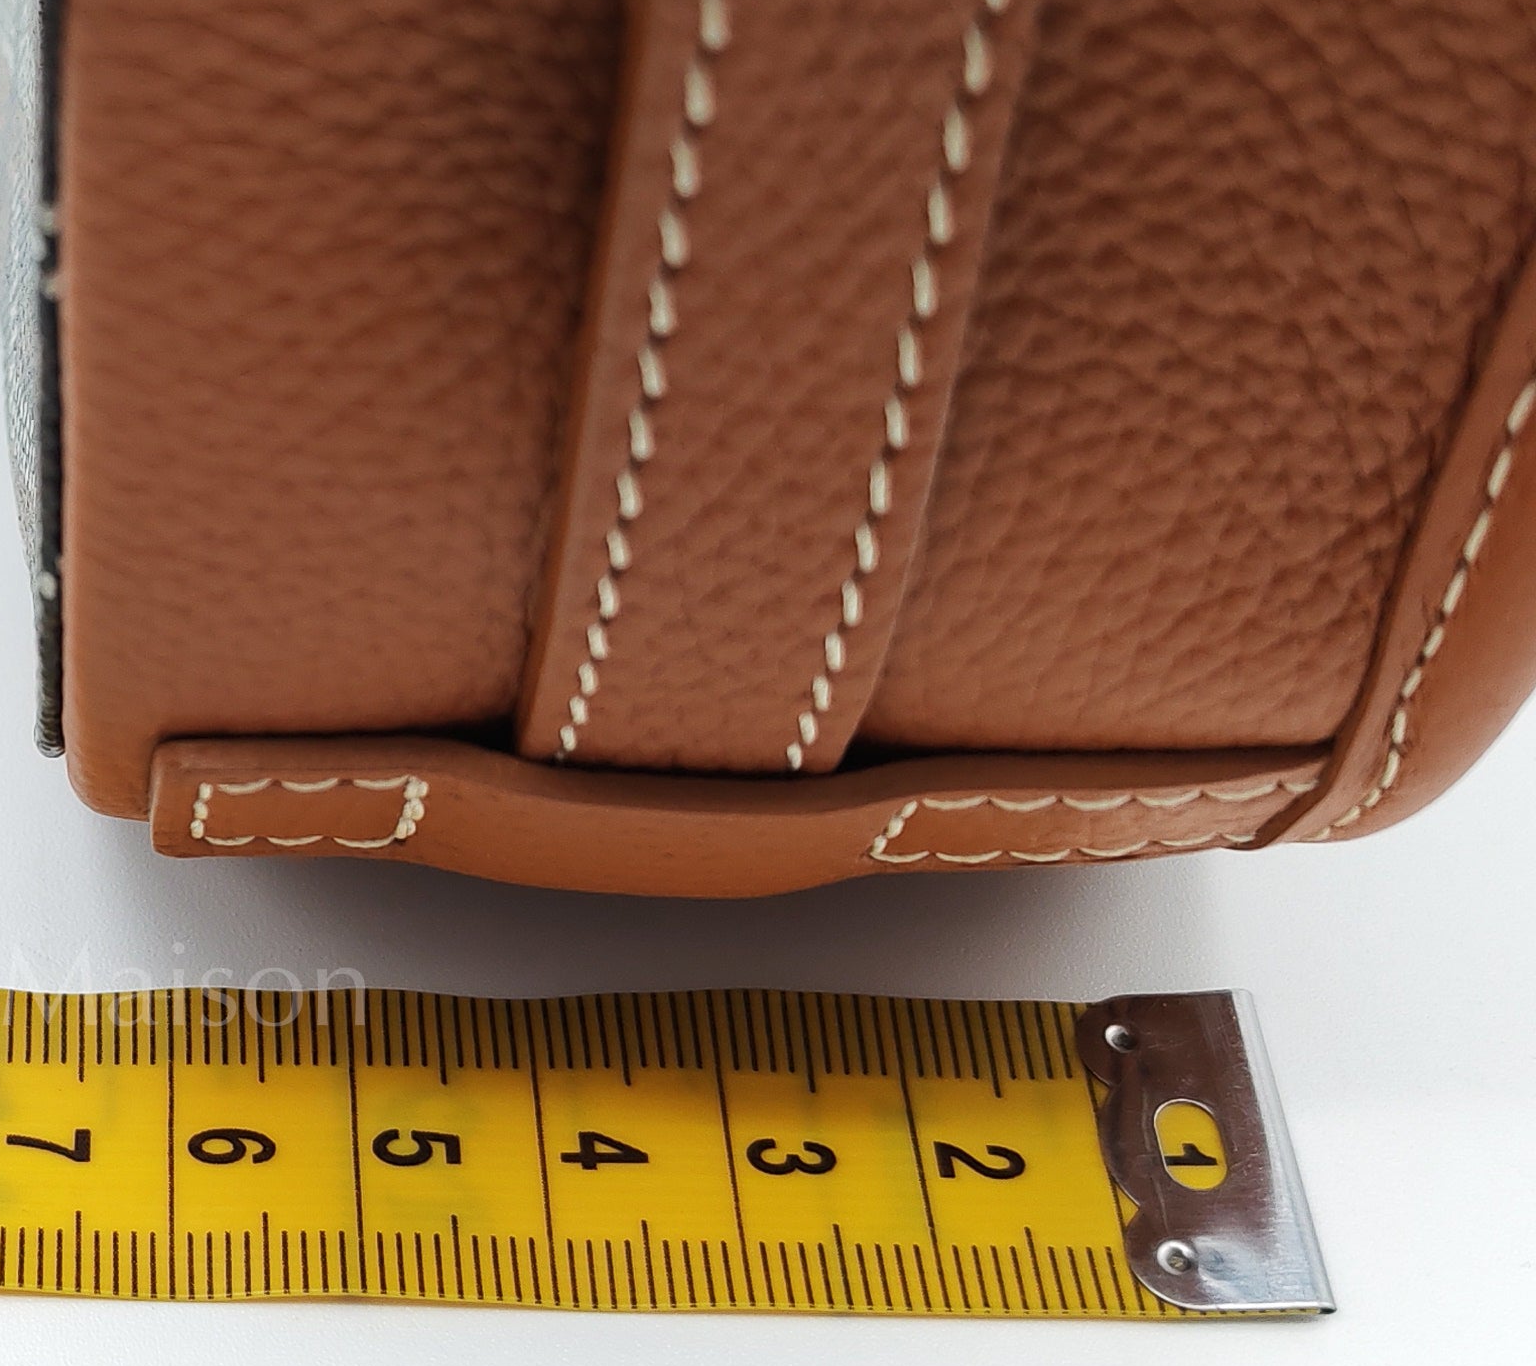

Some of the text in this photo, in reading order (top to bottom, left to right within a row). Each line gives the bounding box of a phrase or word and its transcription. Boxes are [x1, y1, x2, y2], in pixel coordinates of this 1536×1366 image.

[6, 1128, 91, 1163] 7
[187, 1128, 277, 1166] 6
[371, 1128, 463, 1168] 5
[560, 1130, 651, 1171] 4
[746, 1138, 838, 1176] 3
[933, 1140, 1027, 1180] 2
[1166, 1142, 1218, 1166] 1
